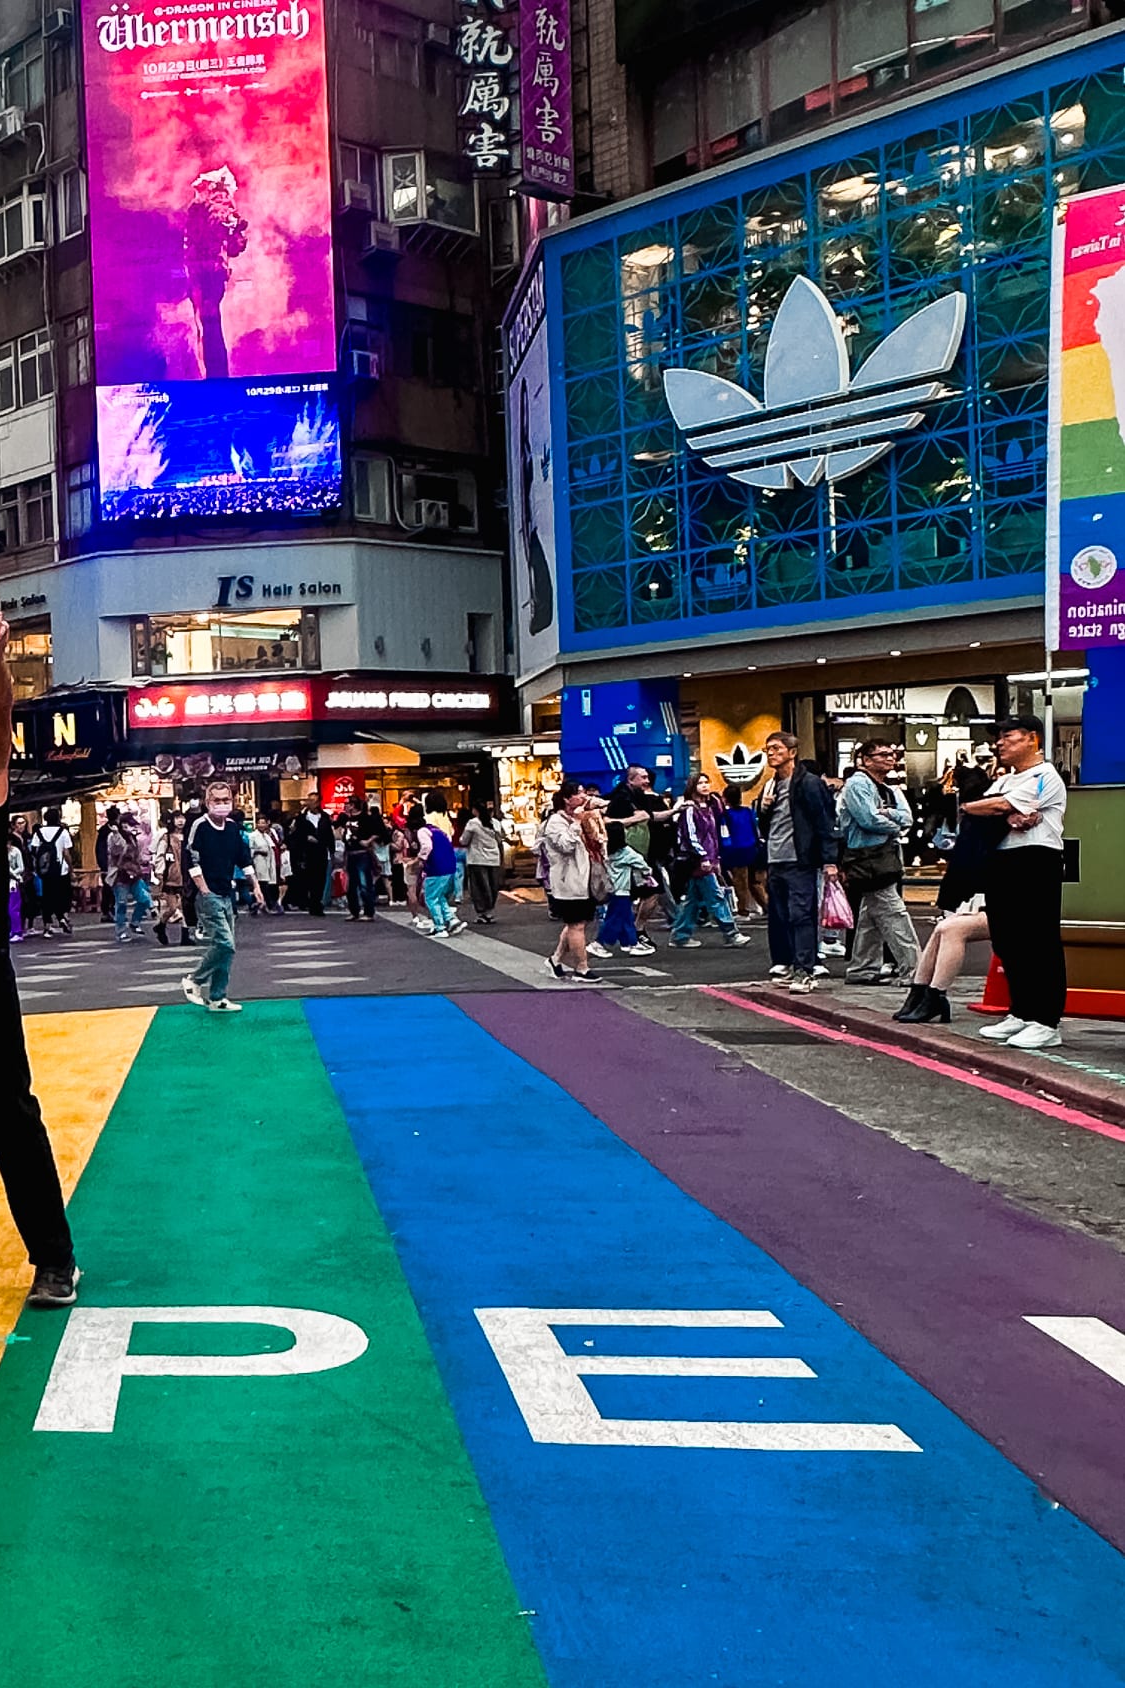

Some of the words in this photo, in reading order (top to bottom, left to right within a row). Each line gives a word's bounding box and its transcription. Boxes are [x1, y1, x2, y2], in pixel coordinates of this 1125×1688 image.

[96, 0, 310, 53] Übermensch
[154, 4, 214, 16] G-DRAGON
[217, 2, 231, 11] IN
[459, 0, 513, 168] 就厲害
[262, 584, 293, 598] Hair
[299, 581, 341, 596] Salon
